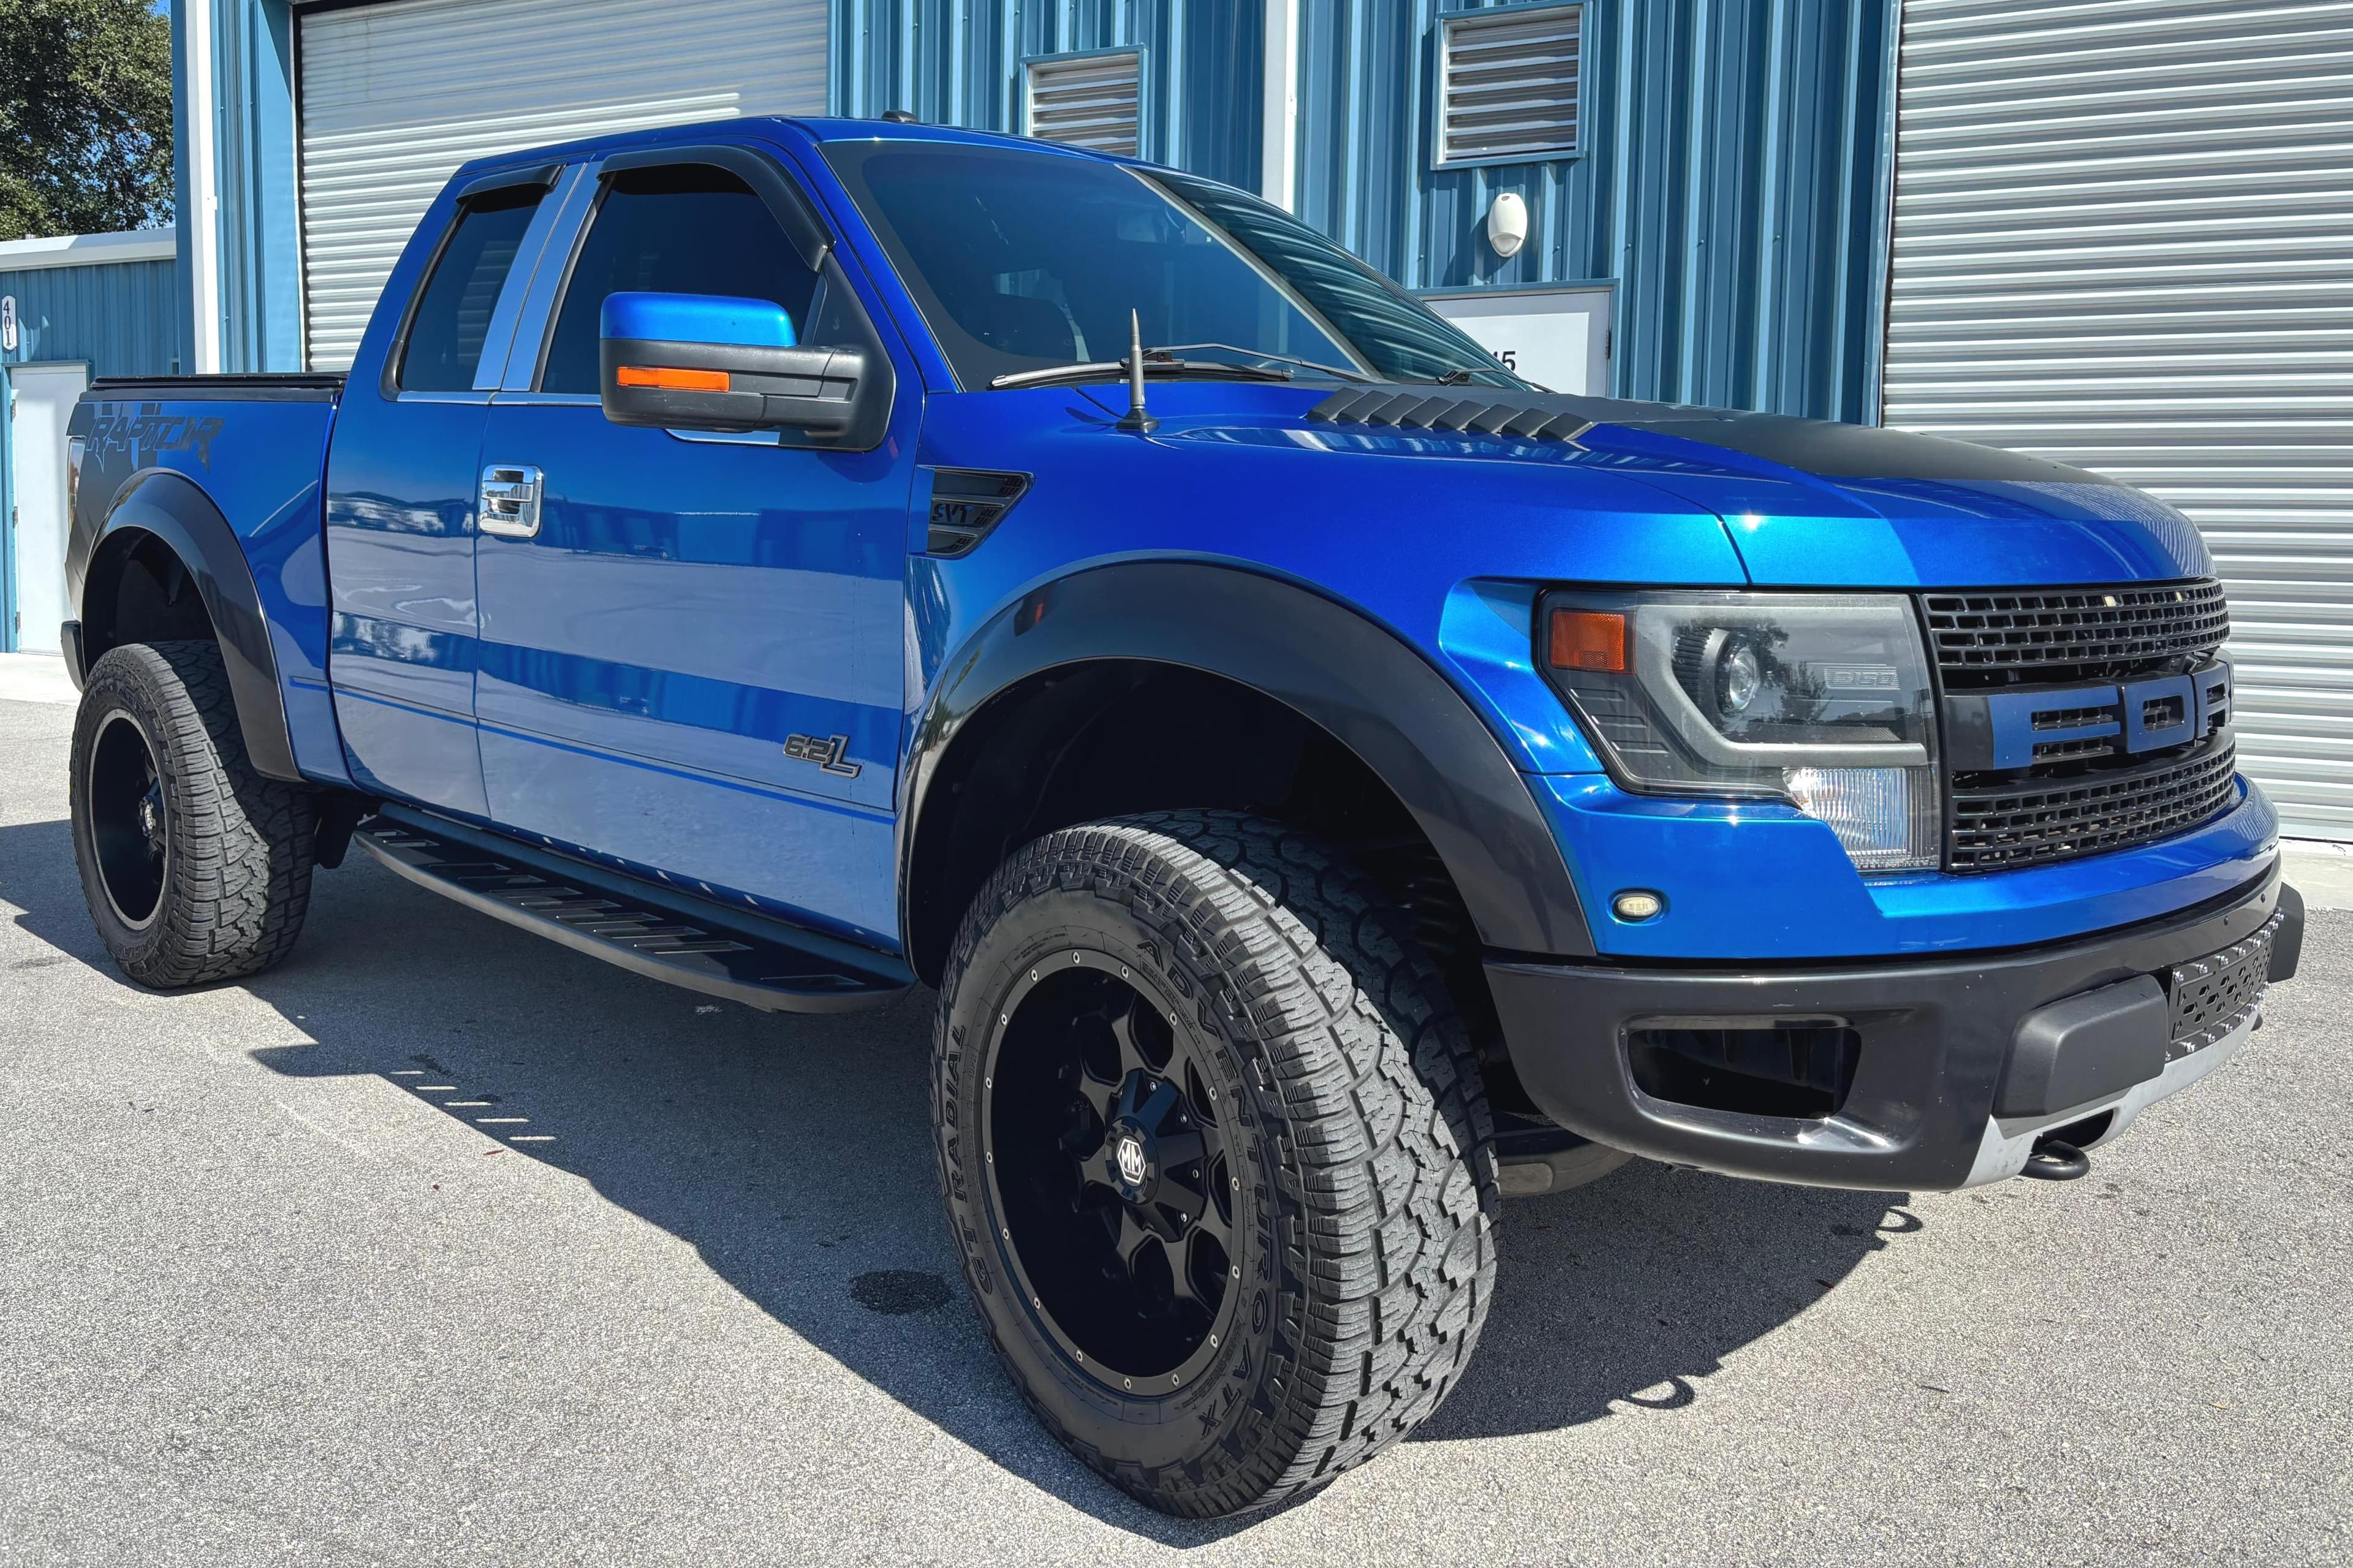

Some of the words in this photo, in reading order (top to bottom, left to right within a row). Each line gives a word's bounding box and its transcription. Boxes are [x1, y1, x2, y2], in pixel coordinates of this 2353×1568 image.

[3, 300, 12, 347] 401
[85, 415, 225, 475] RAPTOR
[931, 503, 974, 523] SVT
[783, 733, 860, 779] 6.2L
[1988, 664, 2235, 770] FOR
[945, 1025, 966, 1203] RADIAL
[1136, 939, 1271, 1336] ADVENTURO
[959, 1215, 992, 1295] GT
[1198, 1338, 1252, 1440] ATX
